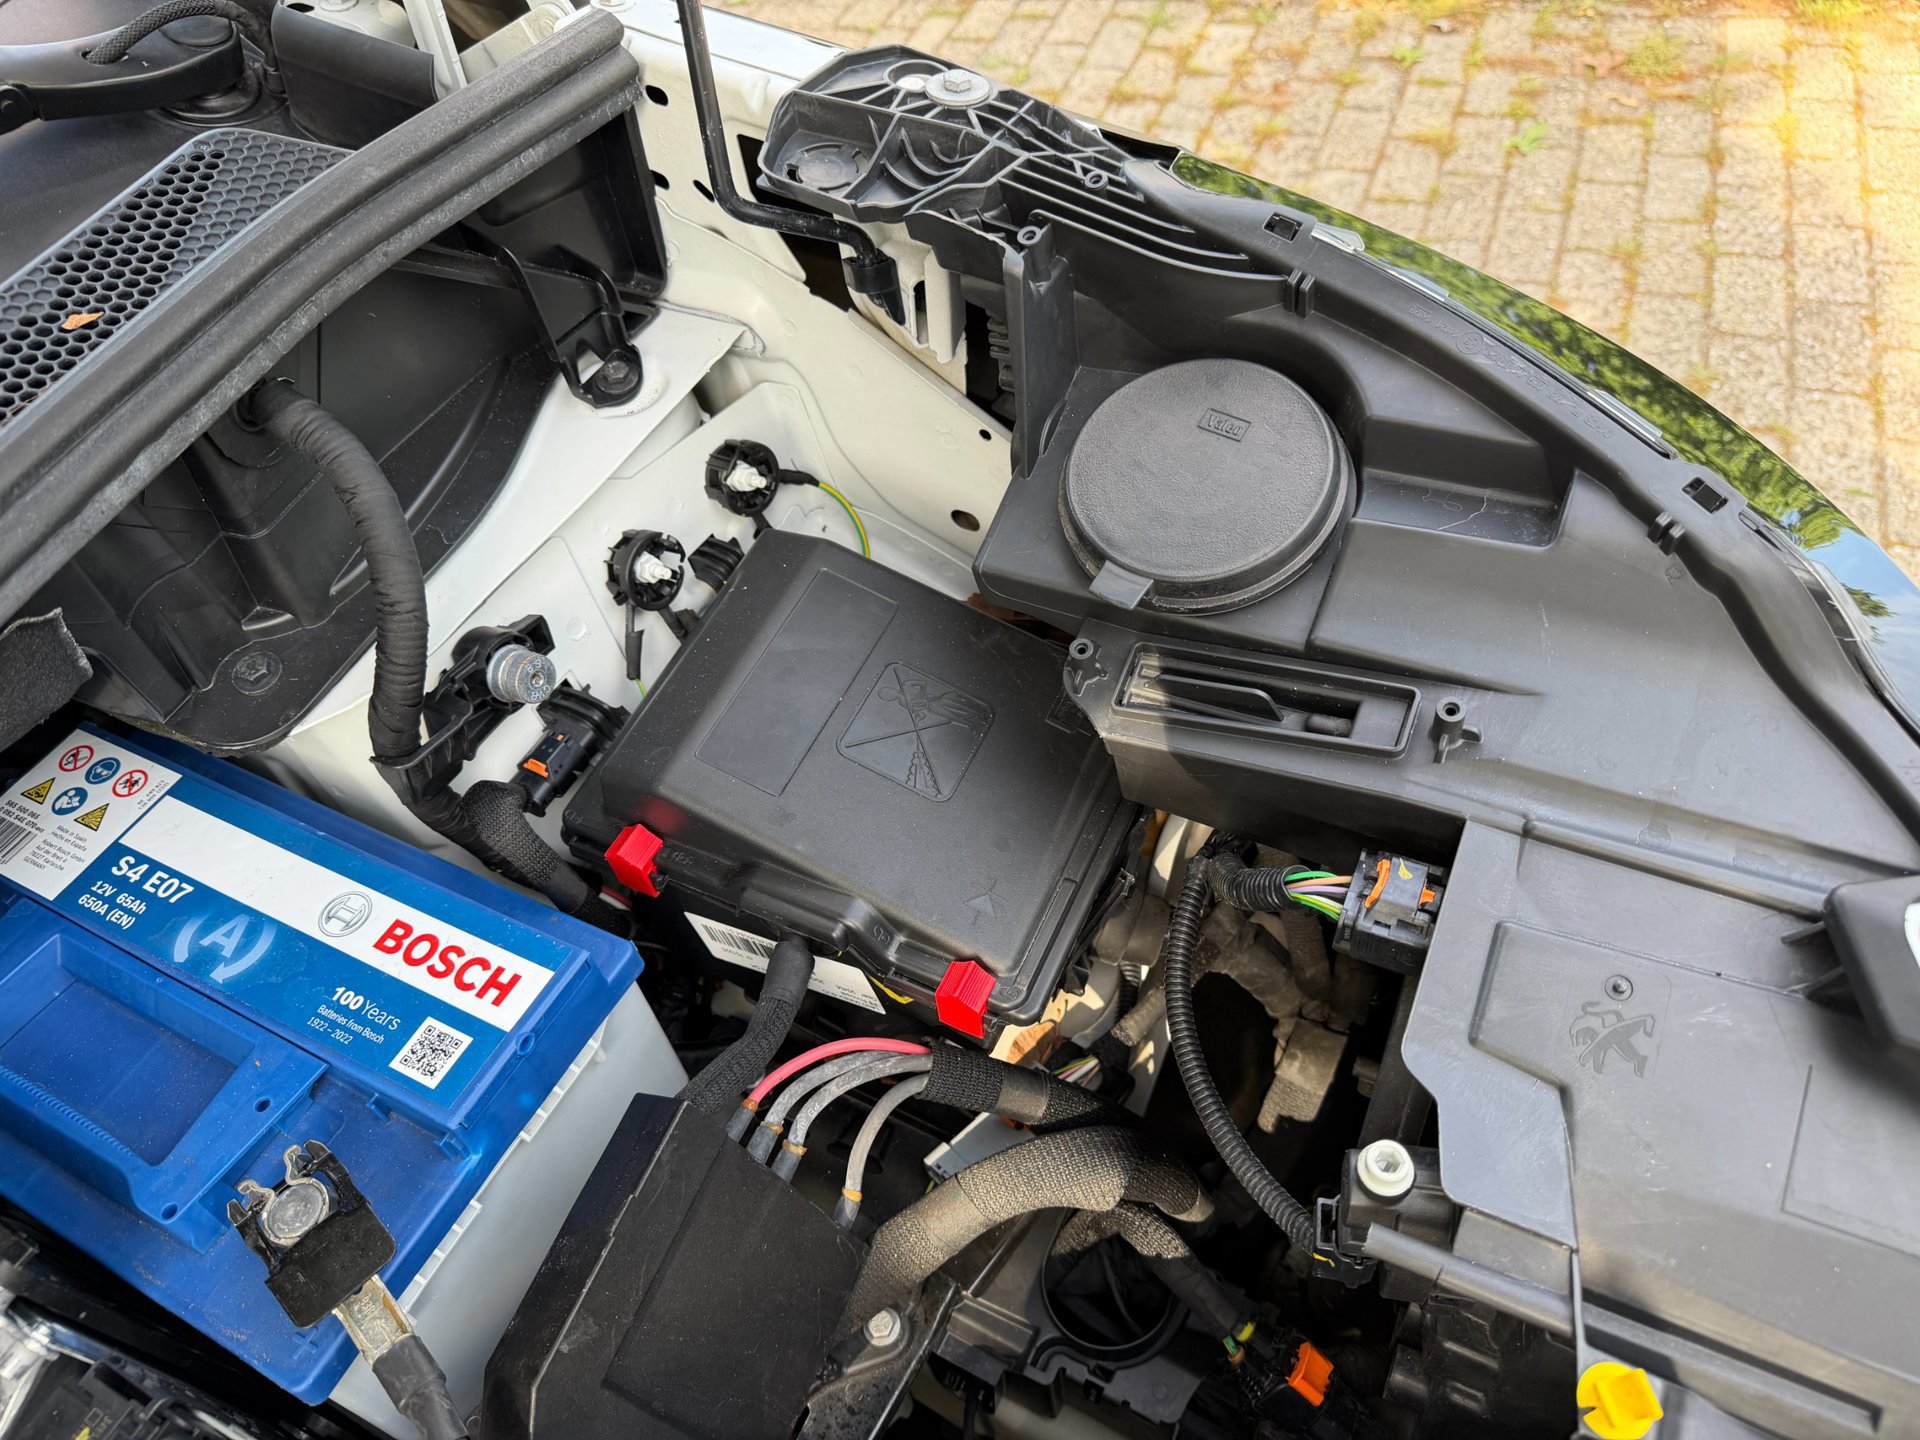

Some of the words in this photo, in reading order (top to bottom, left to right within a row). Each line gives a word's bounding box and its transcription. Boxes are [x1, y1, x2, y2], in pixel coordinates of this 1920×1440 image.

[2, 809, 16, 818] 092
[13, 814, 26, 824] S4E
[5, 800, 18, 809] 565
[16, 804, 29, 814] 500
[27, 811, 41, 820] 065
[51, 831, 65, 841] Hecho
[70, 841, 87, 851] España
[56, 825, 70, 834] Made
[73, 833, 88, 843] Spain
[23, 855, 47, 870] GERMANY
[41, 839, 58, 850] Robert
[56, 846, 71, 857] Bosch
[70, 853, 87, 863] GmbH
[51, 852, 63, 861] Breit
[43, 857, 65, 871] Karlsruhe
[111, 855, 150, 883] S4
[142, 870, 195, 904] E07
[90, 880, 118, 897] 12V
[116, 893, 147, 915] 65Ah
[78, 893, 109, 916] 650A
[106, 908, 136, 930] (EN)
[372, 918, 523, 1008] BOSCH
[332, 986, 365, 1010] 100
[361, 999, 401, 1030] Years
[307, 1016, 329, 1032] 1922
[331, 1028, 354, 1045] 2022
[317, 1004, 348, 1026] Batteries
[346, 1018, 363, 1034] from
[361, 1026, 385, 1044] Bosch
